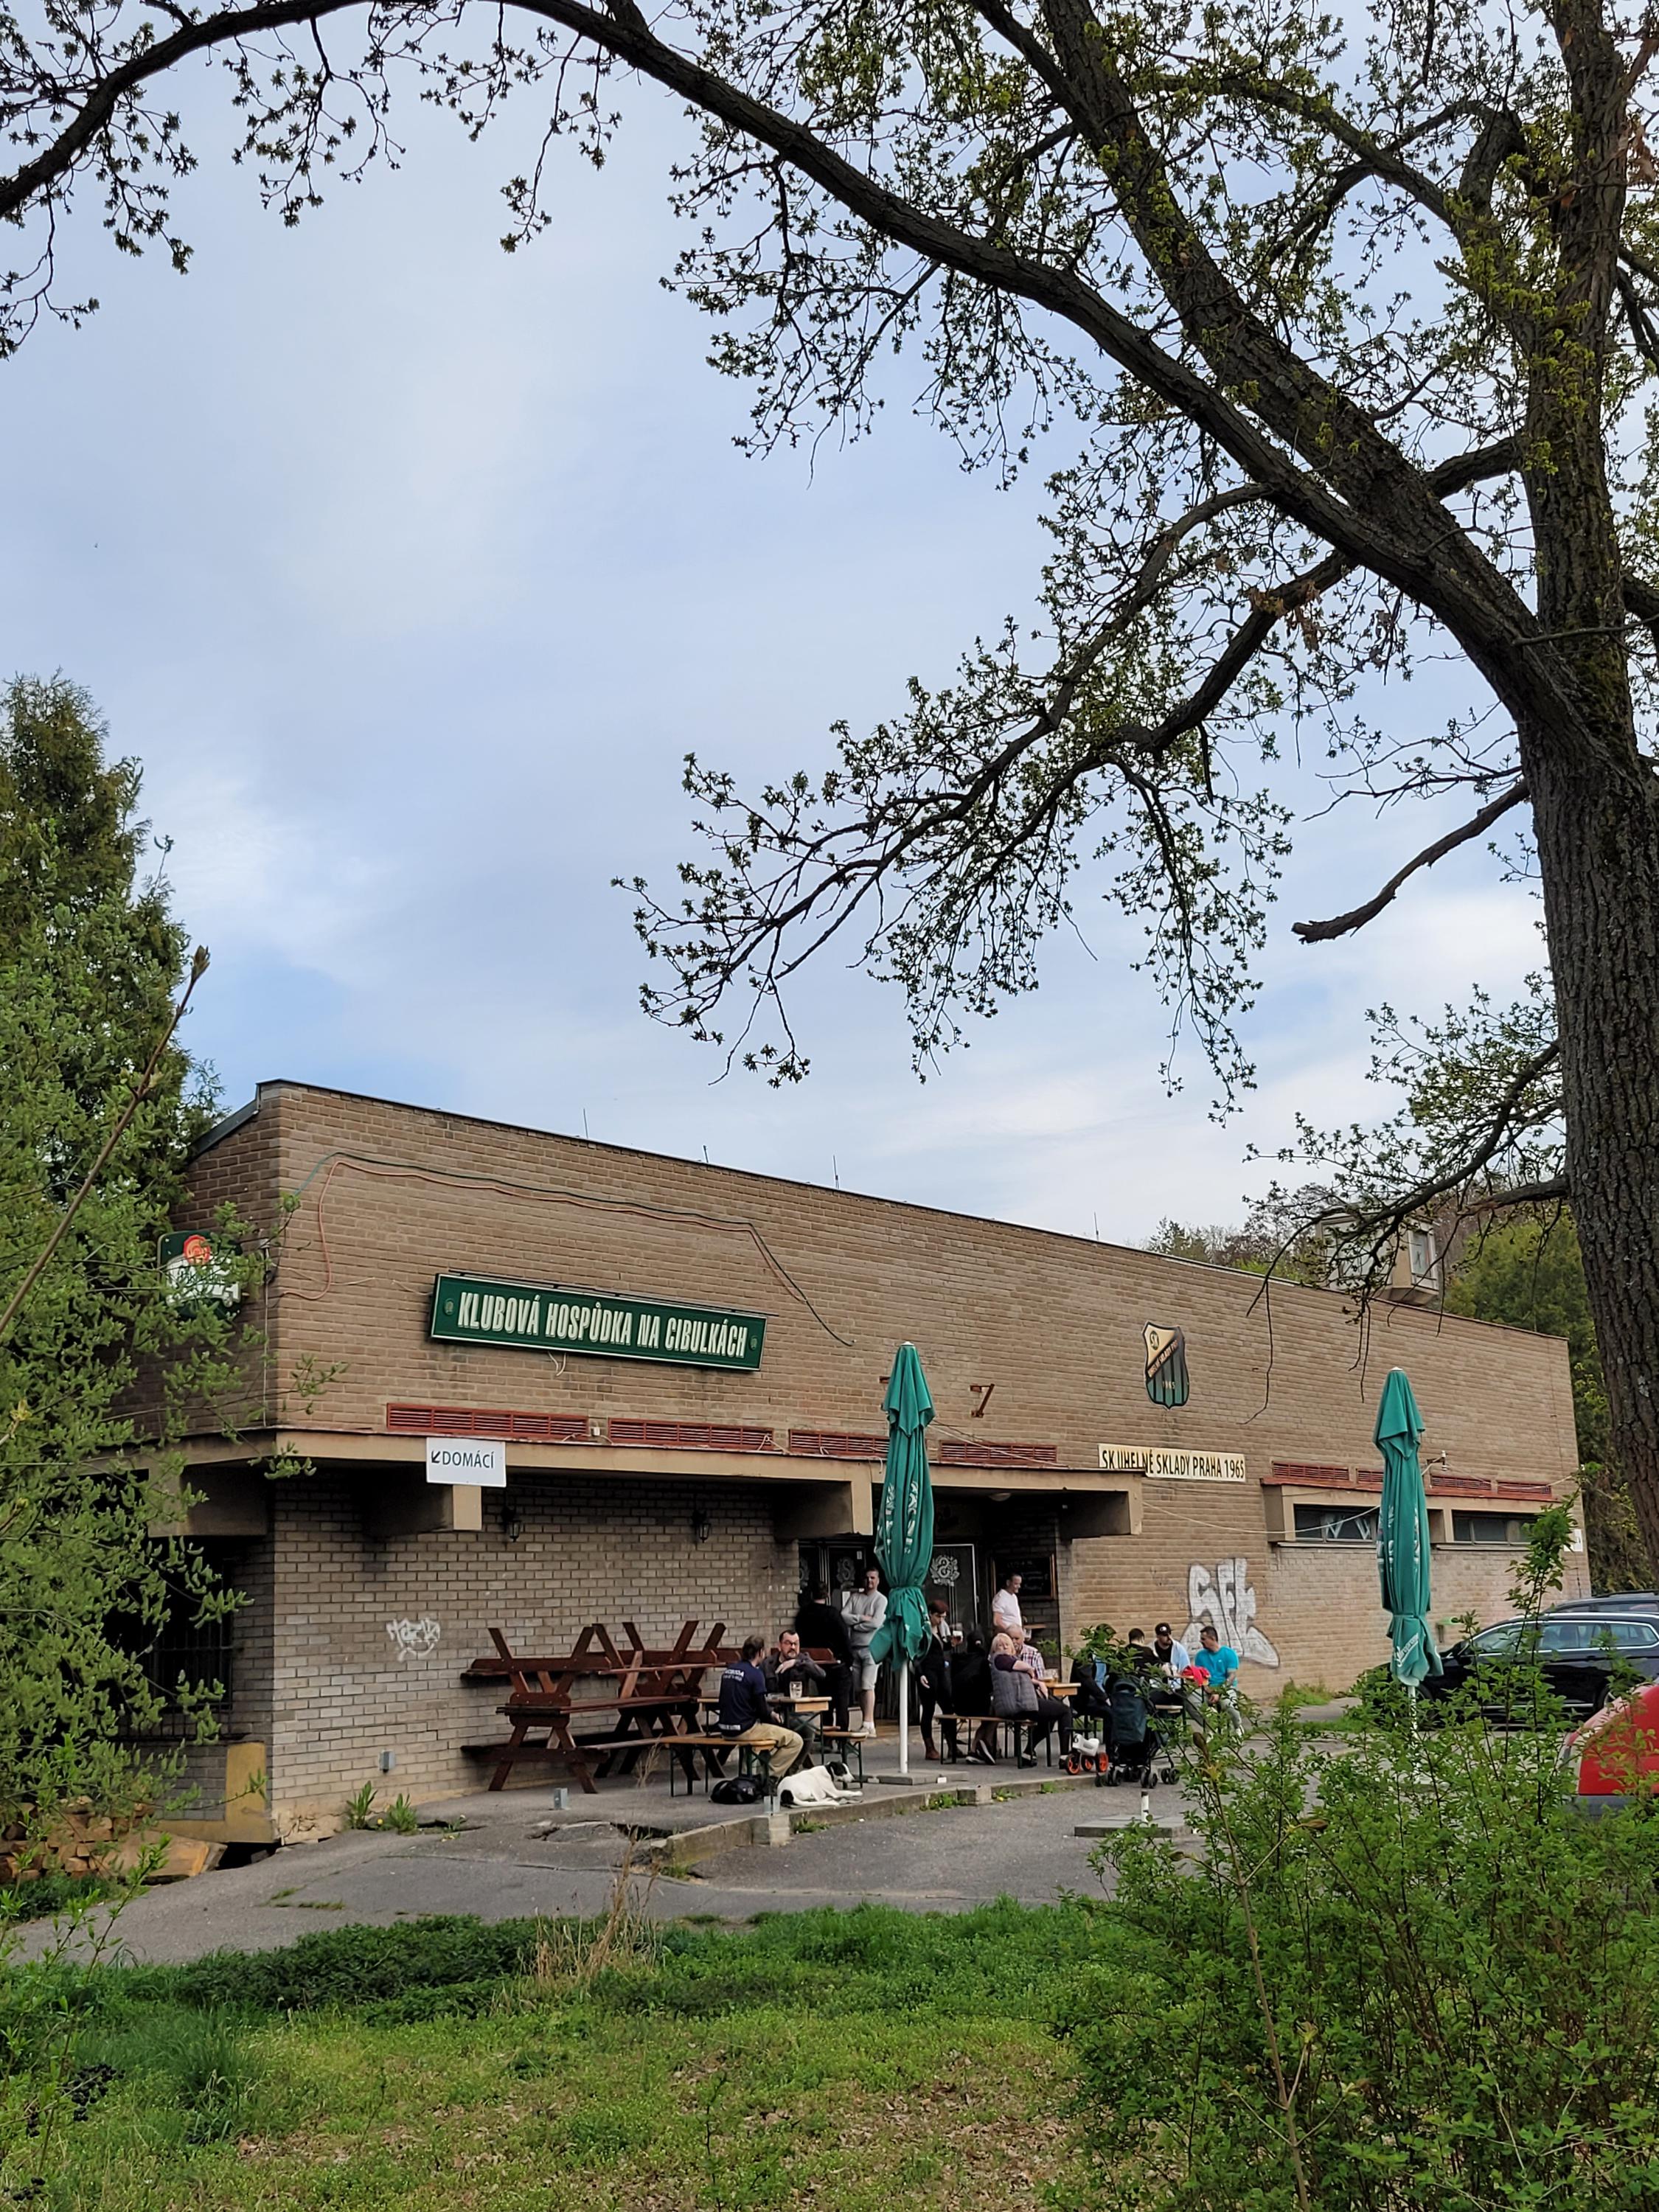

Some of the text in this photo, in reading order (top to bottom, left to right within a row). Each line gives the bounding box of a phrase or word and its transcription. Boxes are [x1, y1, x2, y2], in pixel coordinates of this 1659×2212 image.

[457, 1292, 748, 1358] KLUBOVÁ HOSPŮDKA NA CIBULKÁCH
[442, 1450, 495, 1469] DOMÁCÍ
[1102, 1449, 1245, 1479] SK UHELNÉ SKLADY PRAHA 1965
